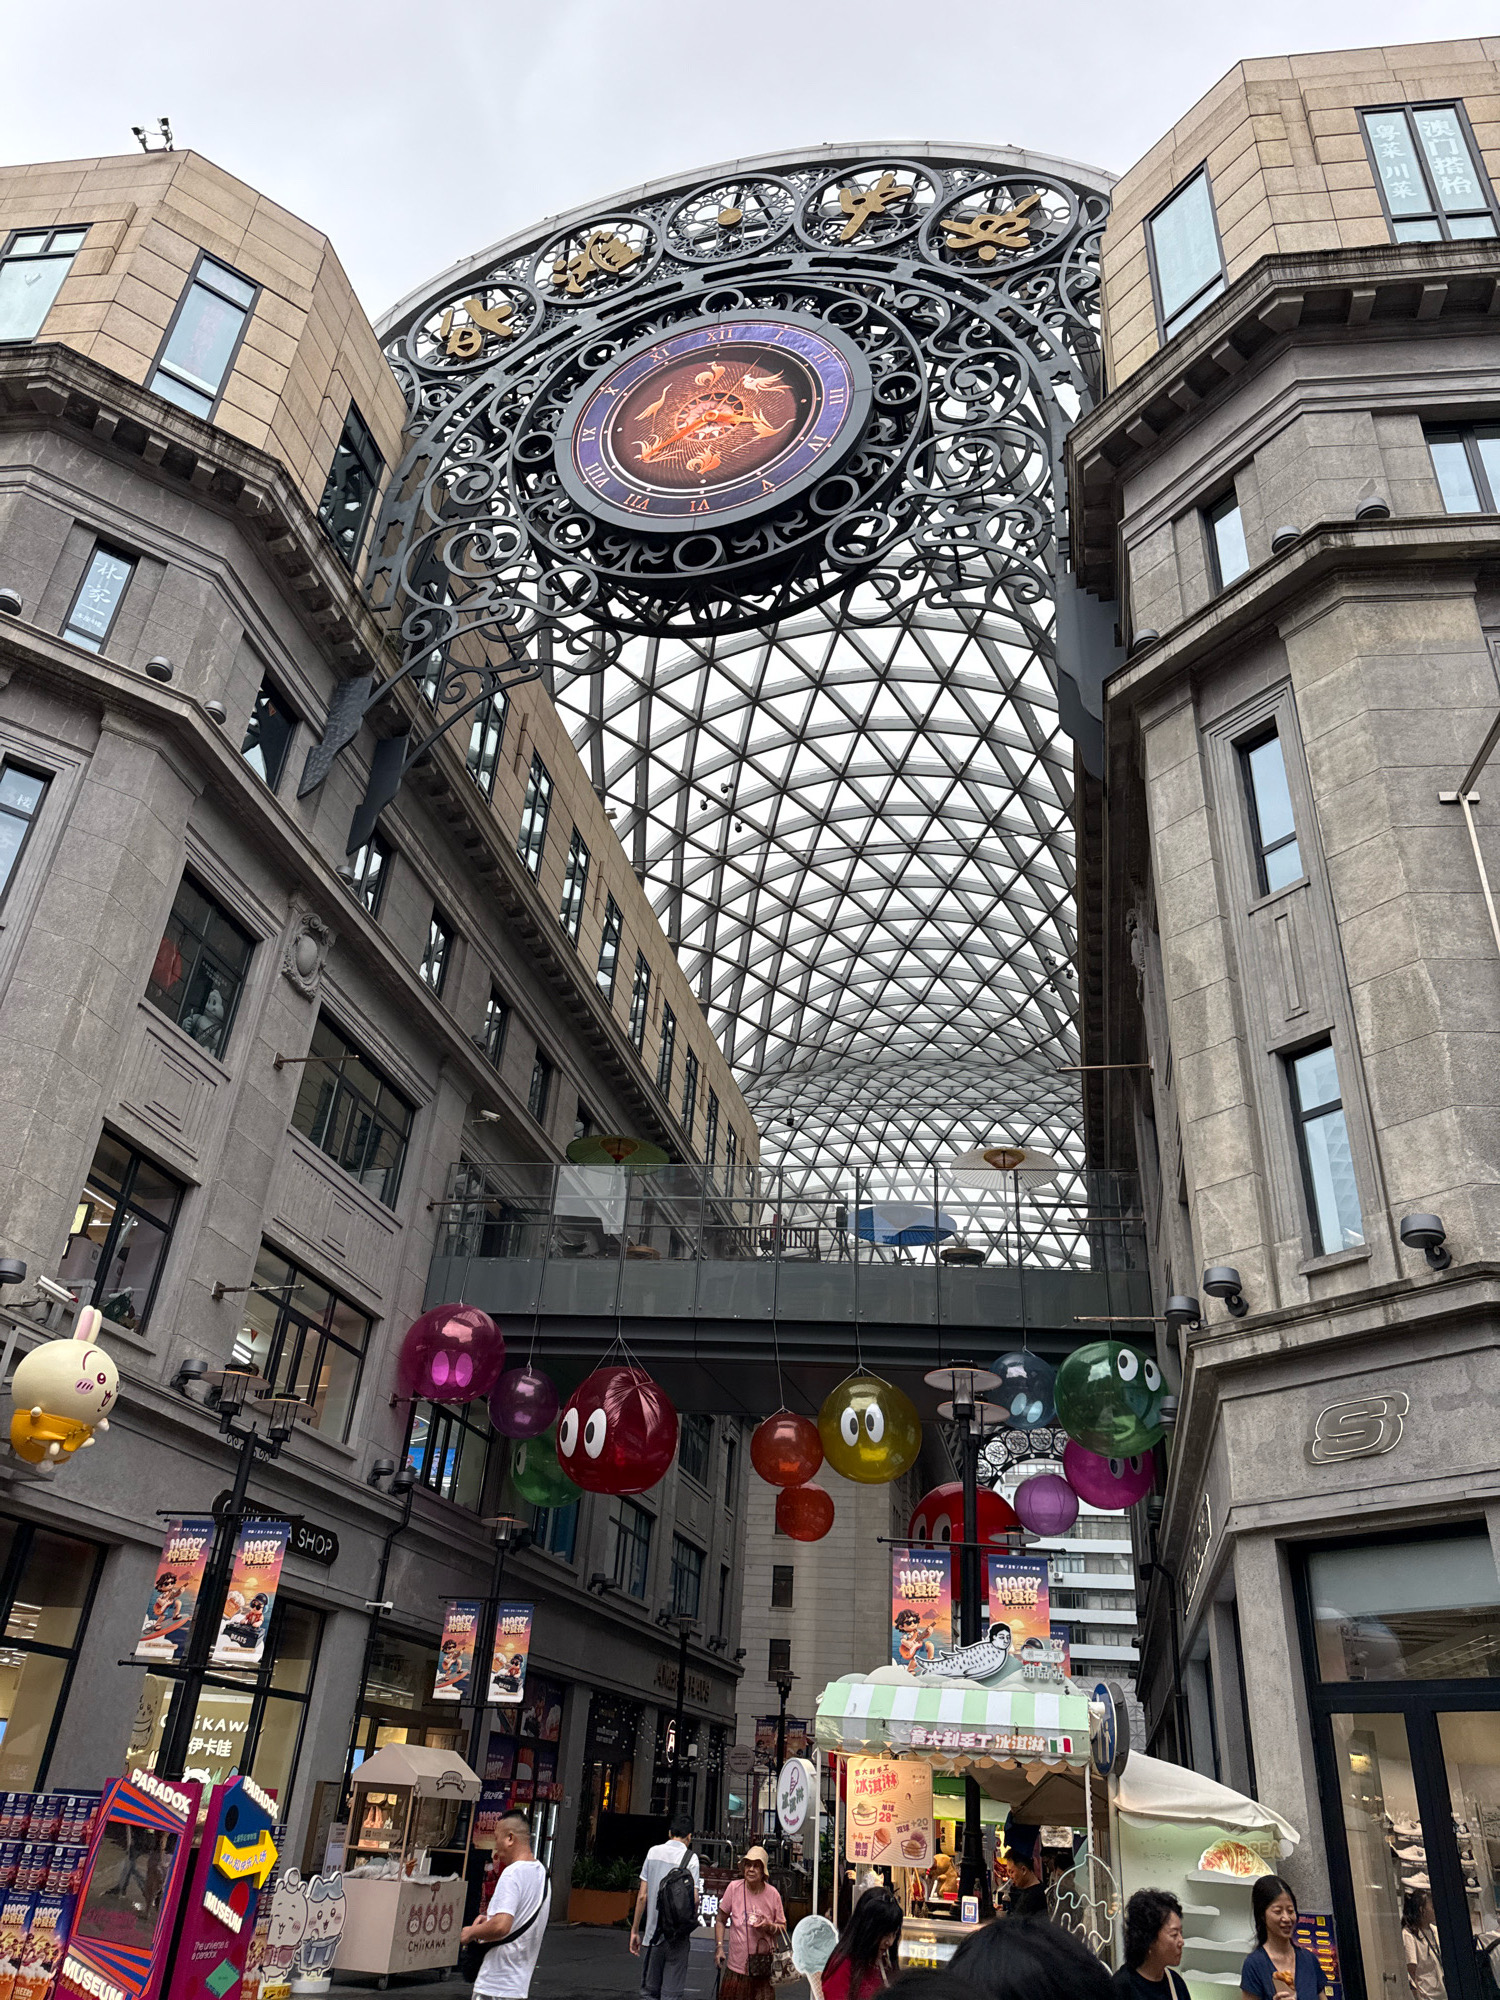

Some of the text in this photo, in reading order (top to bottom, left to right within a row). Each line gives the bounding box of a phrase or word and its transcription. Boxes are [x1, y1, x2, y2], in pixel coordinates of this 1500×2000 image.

[1372, 124, 1419, 199] 粤菜川菜
[170, 1537, 207, 1553] HAPPY
[244, 1539, 281, 1554] HAPPY
[298, 1527, 333, 1557] SHOP
[166, 1548, 201, 1564] 仲夏夜
[241, 1551, 276, 1565] 仲夏夜
[900, 1570, 945, 1585] HAPPY
[996, 1576, 1042, 1592] HAPPY
[899, 1582, 942, 1598] 仲夏夜
[996, 1589, 1040, 1605] 仲夏夜
[230, 1632, 248, 1645] BEATS
[1022, 1662, 1066, 1681] 甜品站
[130, 1767, 192, 1815] PARADOX
[855, 1772, 899, 1795] 冰淇淋
[242, 1775, 279, 1820] PARADOX
[879, 1811, 892, 1823] 28
[3, 1902, 31, 1917] HAPPY
[34, 1906, 63, 1920] HAPPY
[203, 1891, 243, 1935] MUSEUM
[62, 1956, 124, 2000] MUSEUM
